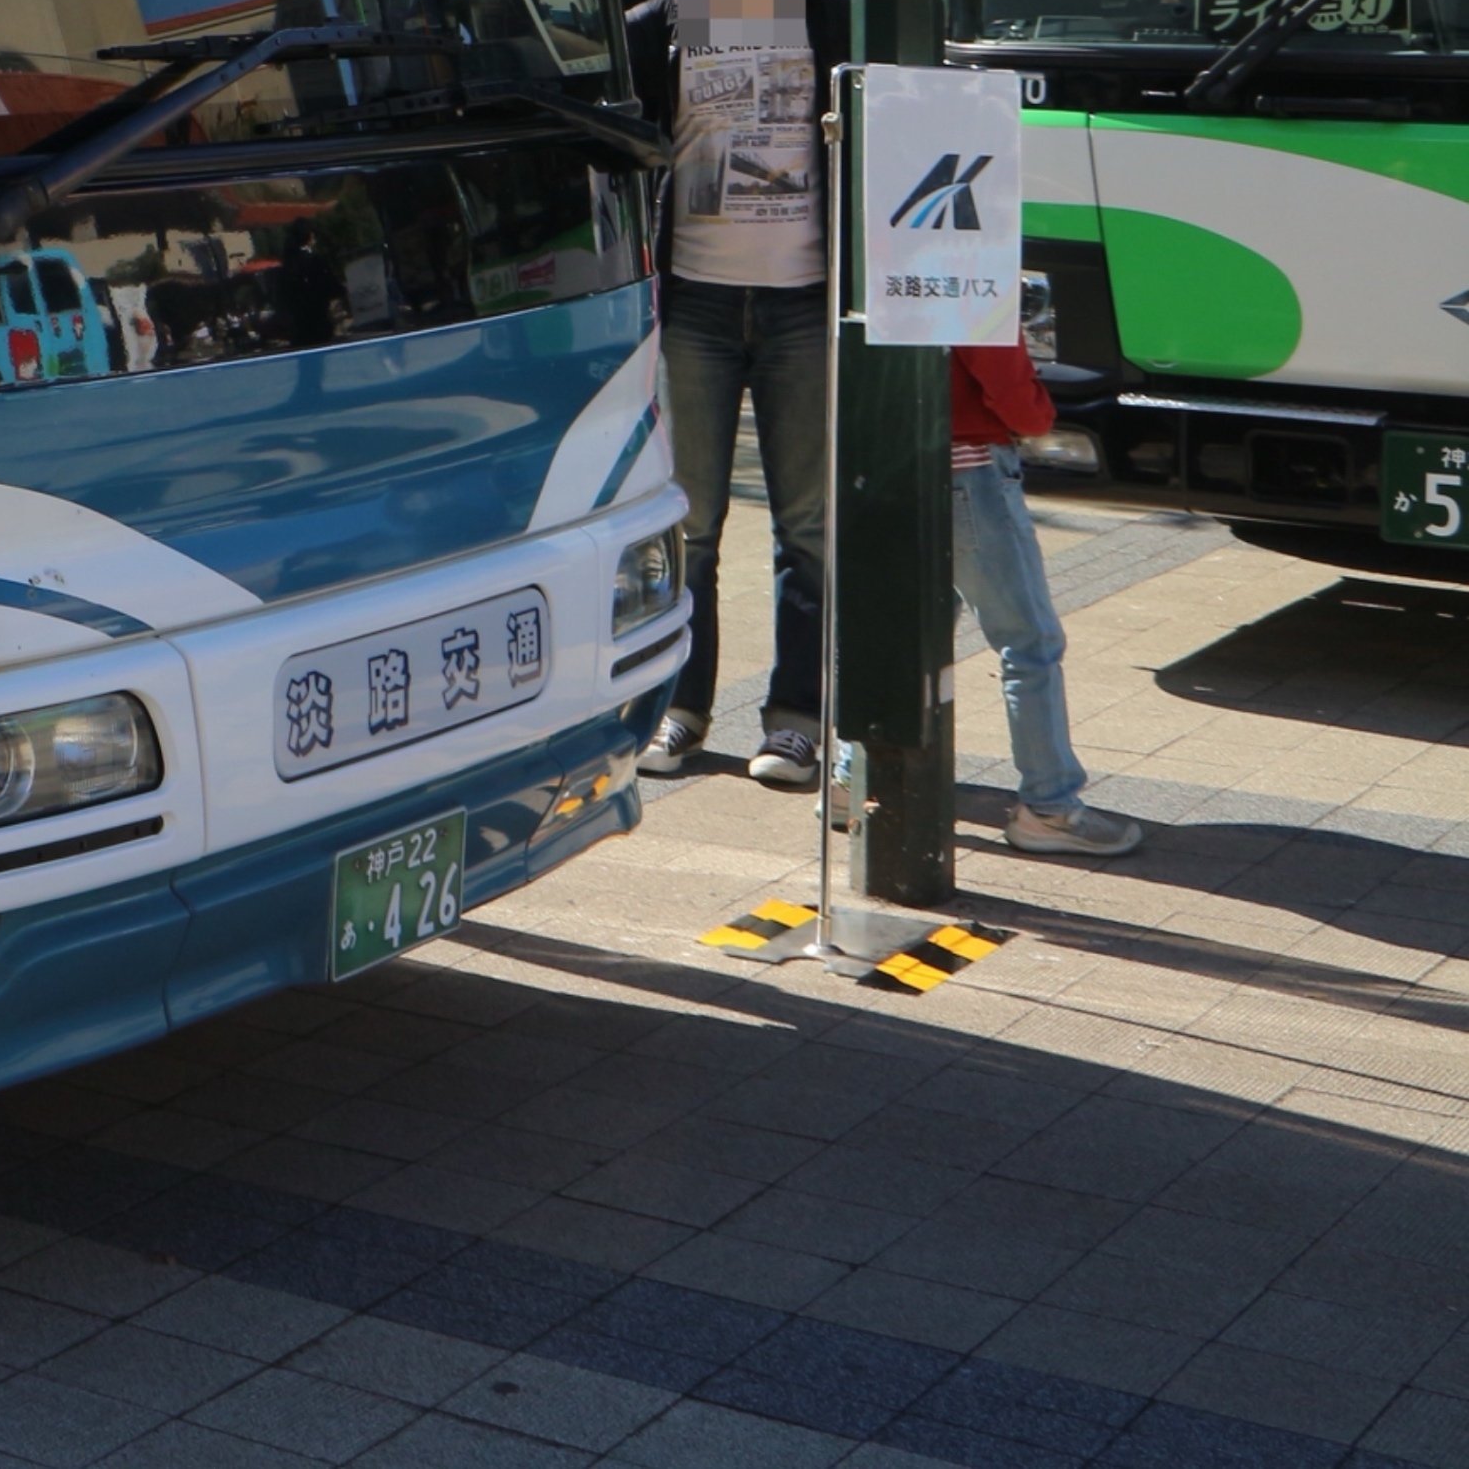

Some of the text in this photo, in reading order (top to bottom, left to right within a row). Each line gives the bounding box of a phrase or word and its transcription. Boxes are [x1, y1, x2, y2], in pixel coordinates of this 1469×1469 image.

[886, 275, 998, 298] 淡路交通バス
[1441, 446, 1469, 469] 神
[1393, 472, 1462, 537] か 5
[286, 606, 544, 757] 淡路交通
[340, 920, 357, 950] あ
